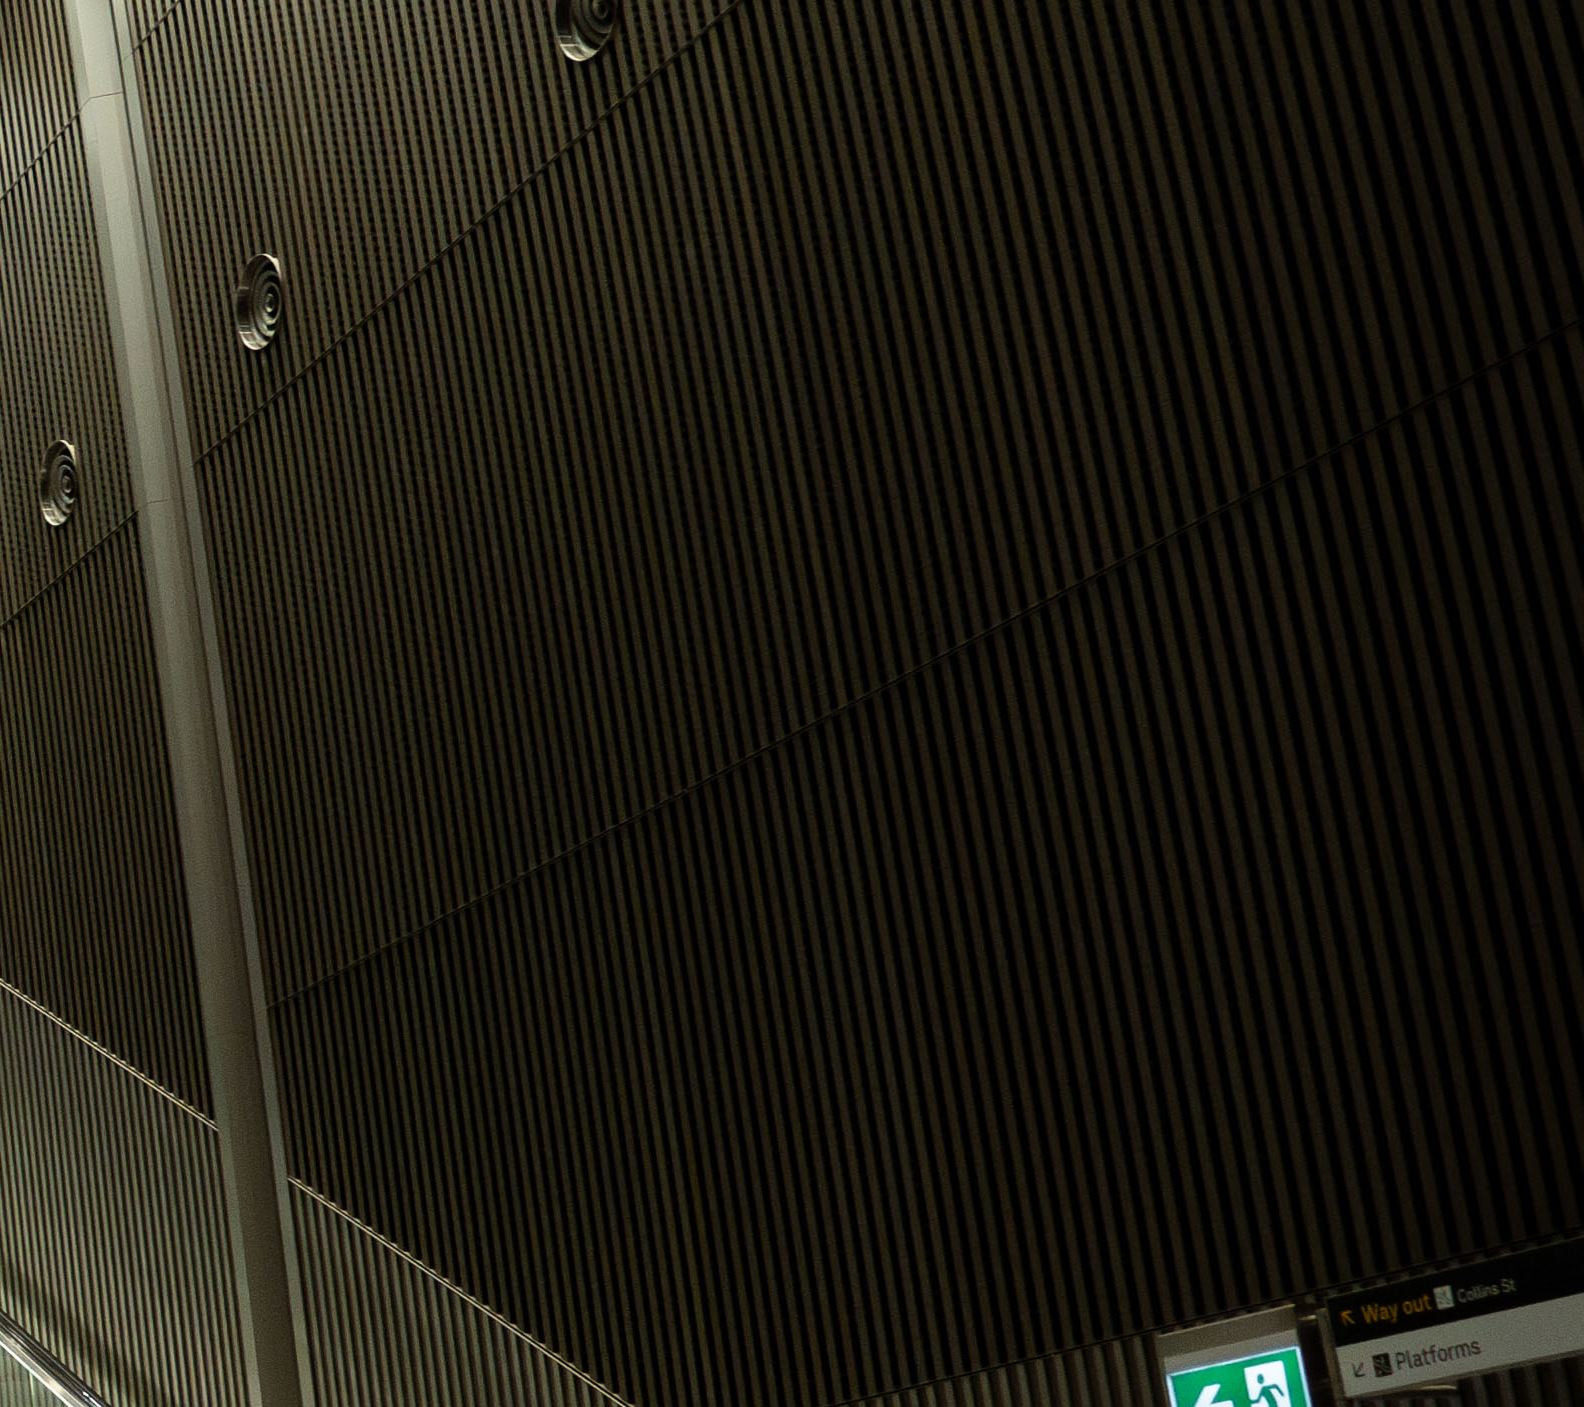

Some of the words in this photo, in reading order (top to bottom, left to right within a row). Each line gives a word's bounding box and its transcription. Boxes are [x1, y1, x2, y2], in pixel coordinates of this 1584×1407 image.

[1360, 1303, 1400, 1325] Way
[1402, 1293, 1434, 1316] out
[1456, 1283, 1500, 1304] Collins
[1500, 1277, 1517, 1293] St
[1394, 1340, 1482, 1371] Platforms
